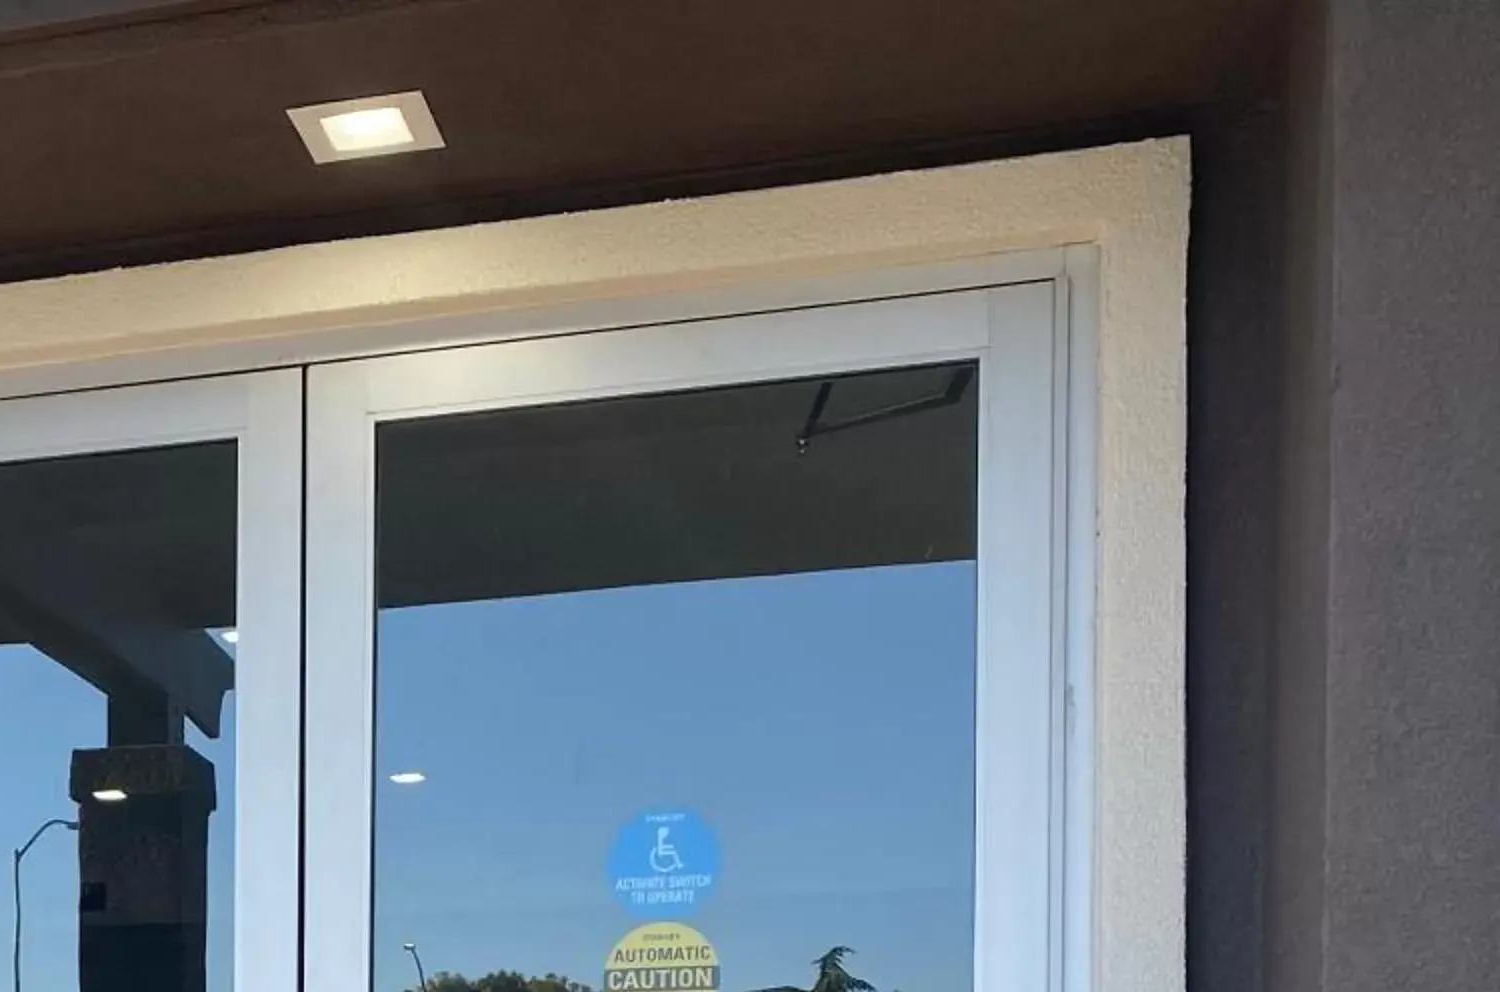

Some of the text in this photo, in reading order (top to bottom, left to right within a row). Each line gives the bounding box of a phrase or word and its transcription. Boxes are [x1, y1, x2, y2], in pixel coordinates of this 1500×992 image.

[668, 873, 712, 888] SWITCH
[614, 945, 711, 963] AUTOMATIC
[608, 968, 713, 991] CAUTION
